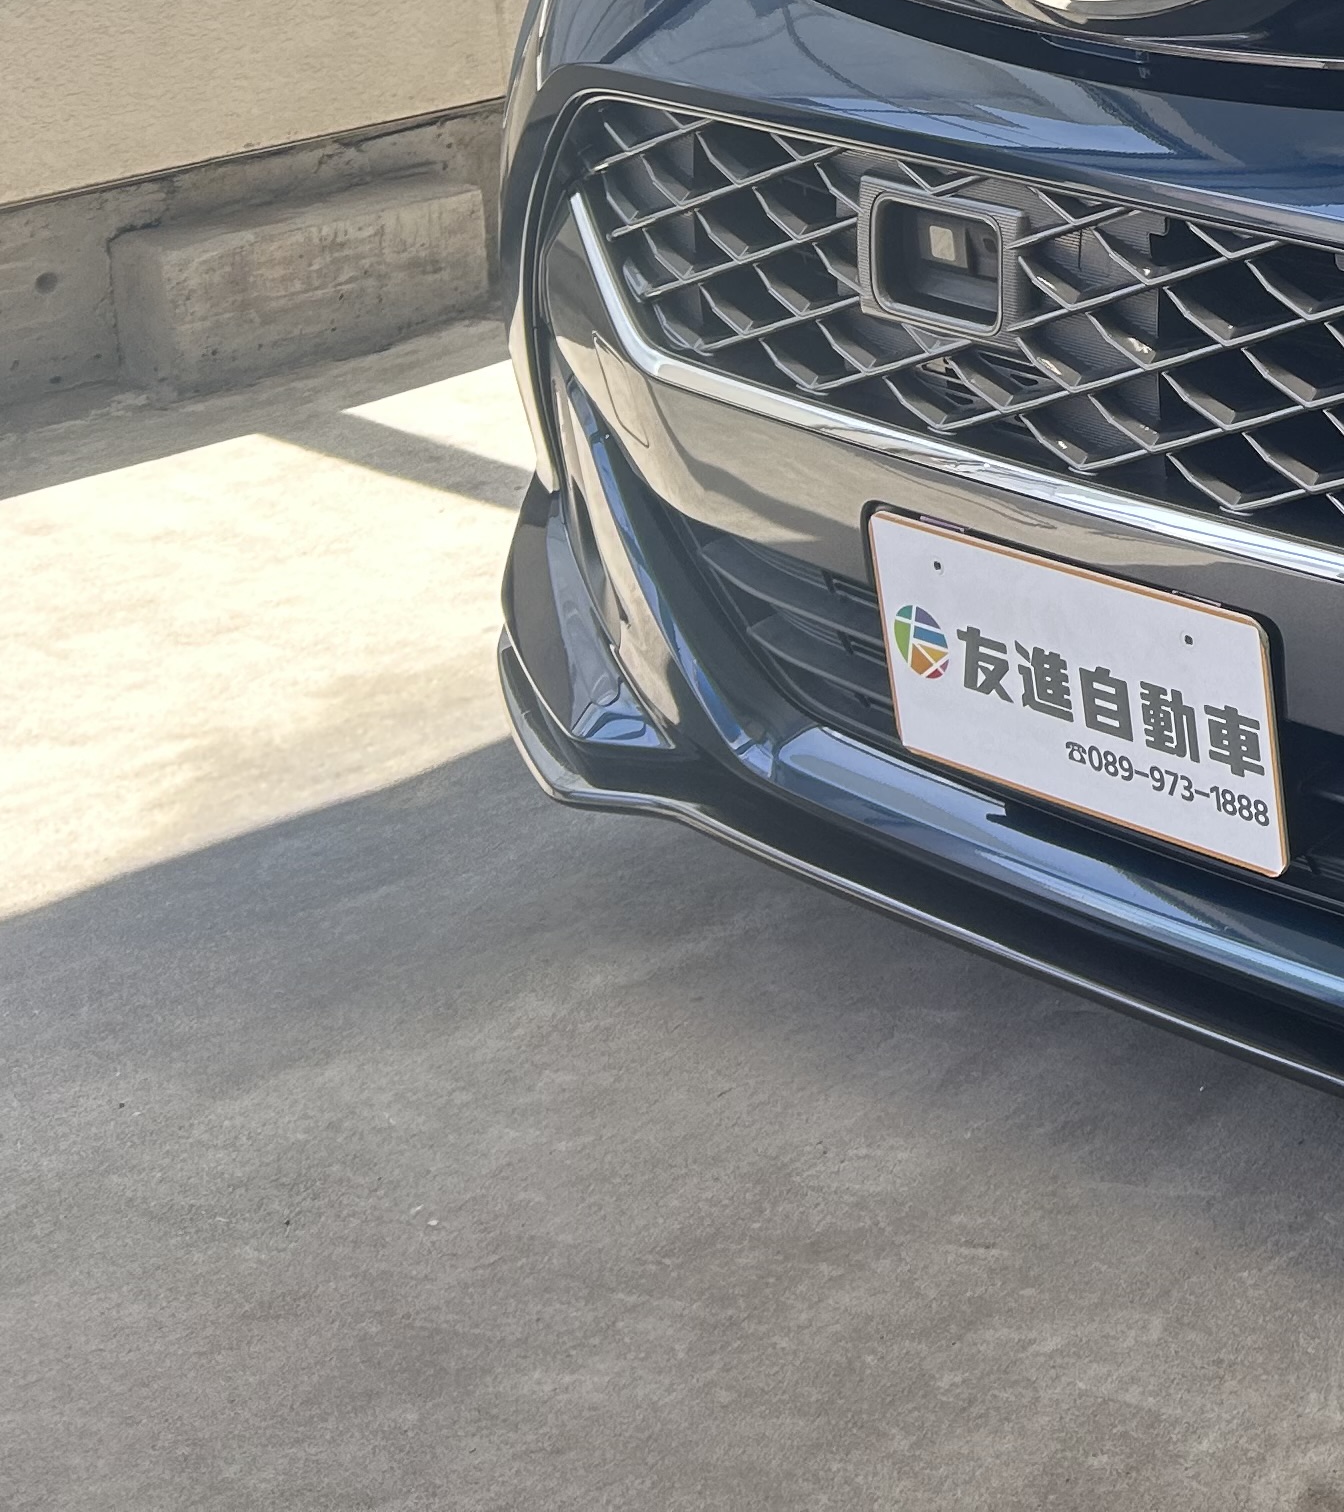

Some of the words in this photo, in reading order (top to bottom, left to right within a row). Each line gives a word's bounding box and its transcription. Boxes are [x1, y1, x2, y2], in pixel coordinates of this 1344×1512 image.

[957, 626, 1265, 777] 友進自動車
